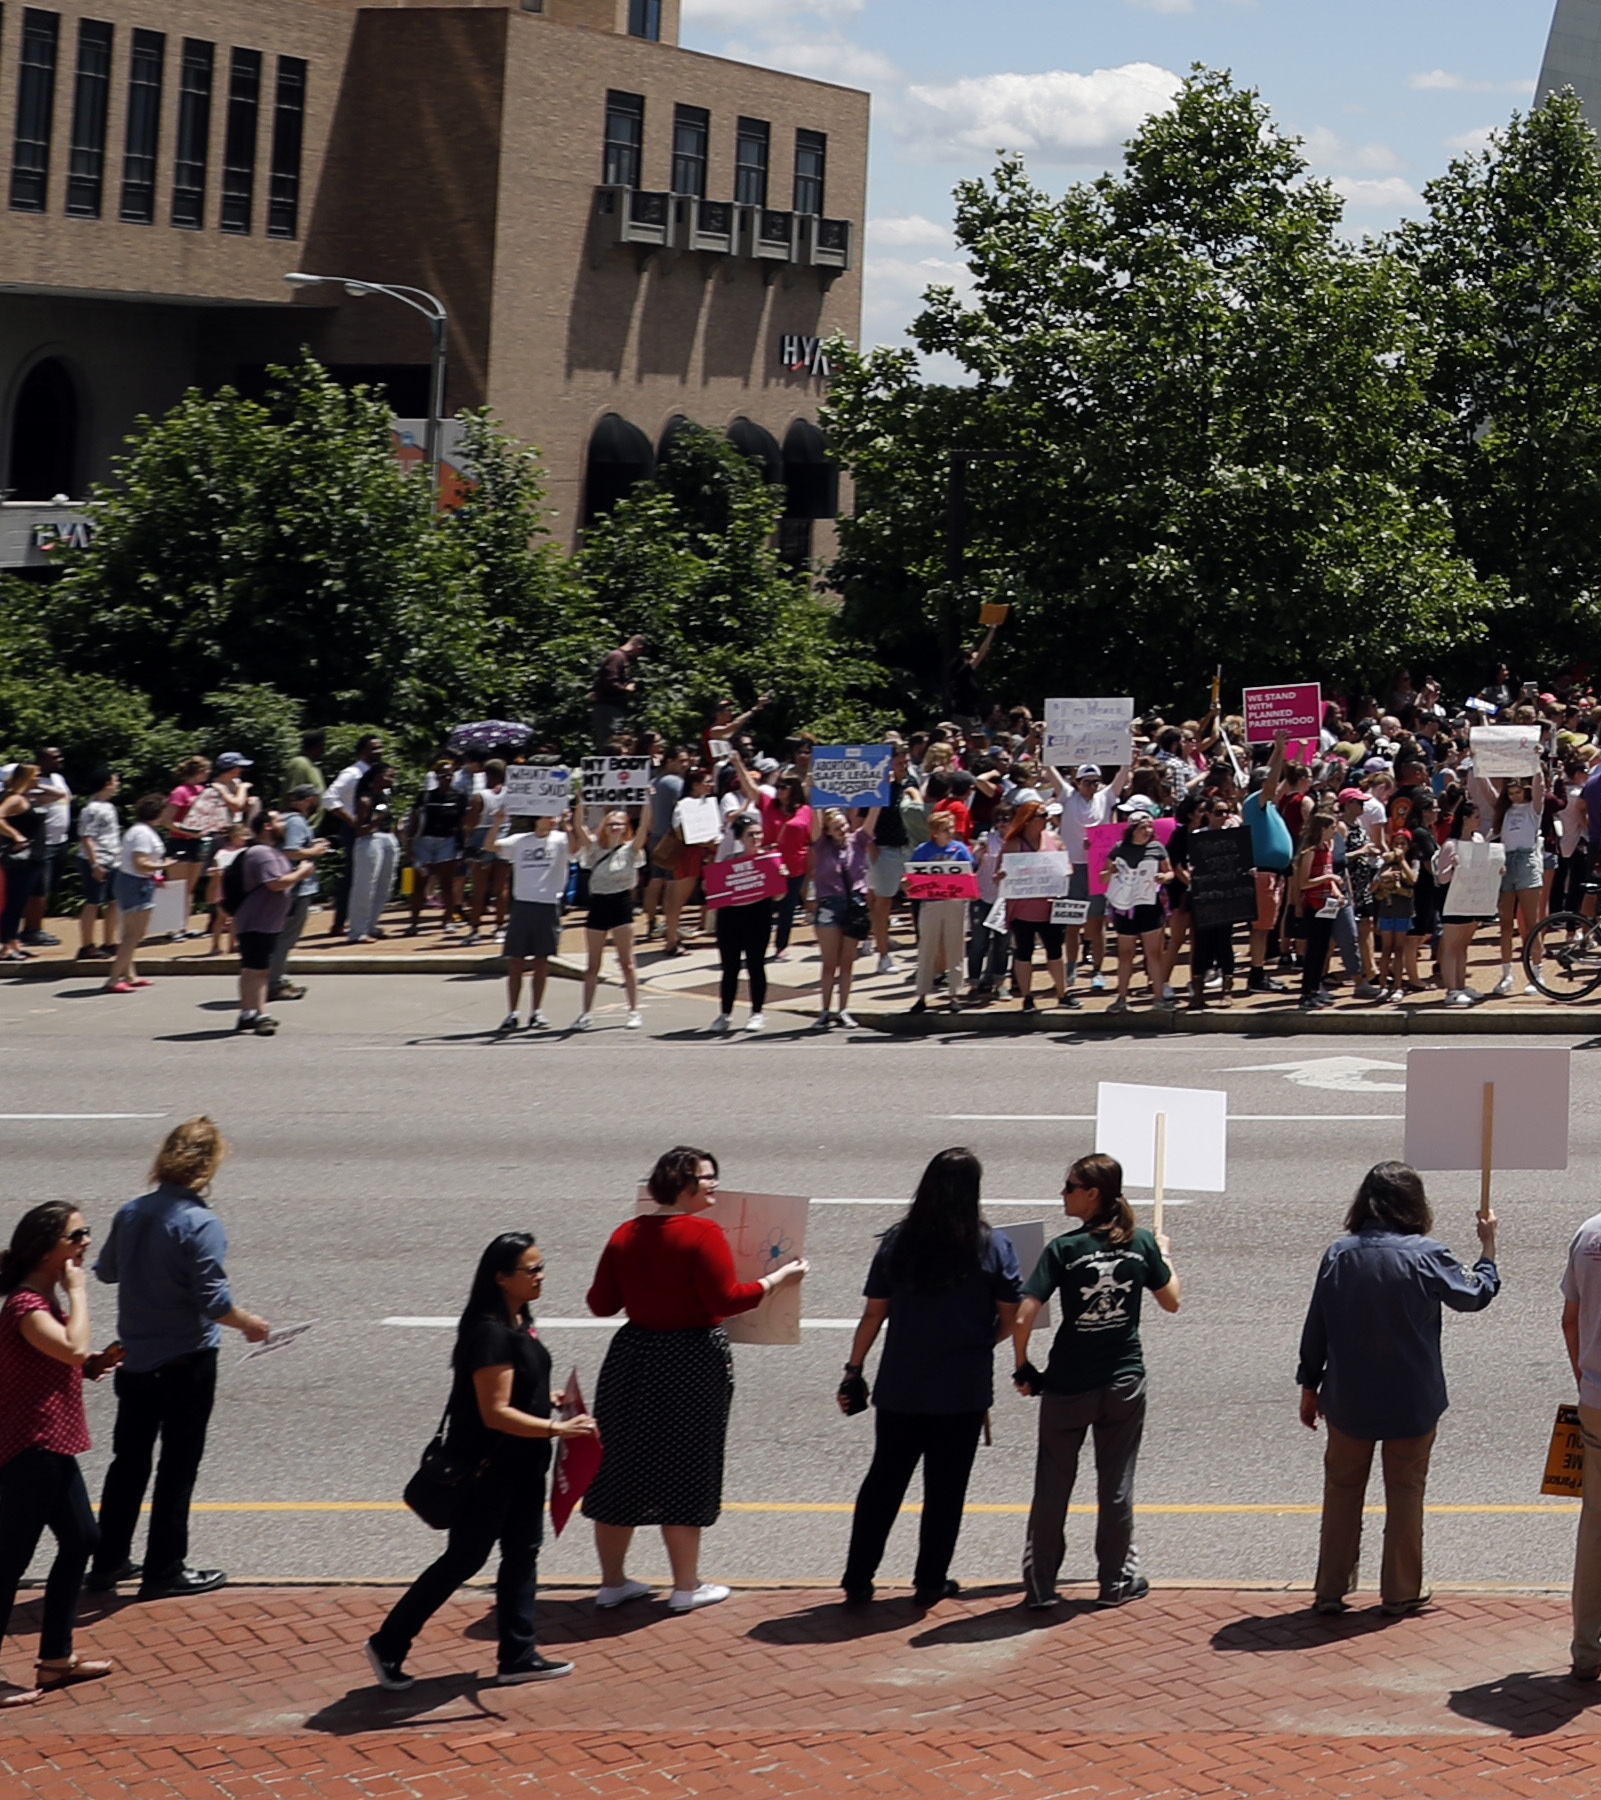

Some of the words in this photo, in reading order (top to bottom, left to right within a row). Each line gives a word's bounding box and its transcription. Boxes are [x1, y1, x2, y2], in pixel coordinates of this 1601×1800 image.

[782, 335, 832, 376] HYA
[1265, 692, 1297, 701] STAND
[1248, 702, 1273, 711] WITH
[1248, 709, 1293, 719] PLANNED
[1248, 716, 1315, 728] PARENTHOOD
[583, 757, 606, 771] MY
[609, 757, 648, 771] BODY
[815, 760, 857, 771] ABORTION
[509, 768, 547, 782] WHAT
[583, 773, 605, 788] MY
[847, 769, 882, 780] LEGAL
[507, 782, 534, 797] SHE
[583, 788, 647, 804] CHOICE
[731, 861, 754, 873] WE
[1053, 901, 1087, 910] NEVER
[1053, 910, 1085, 919] AGAIN
